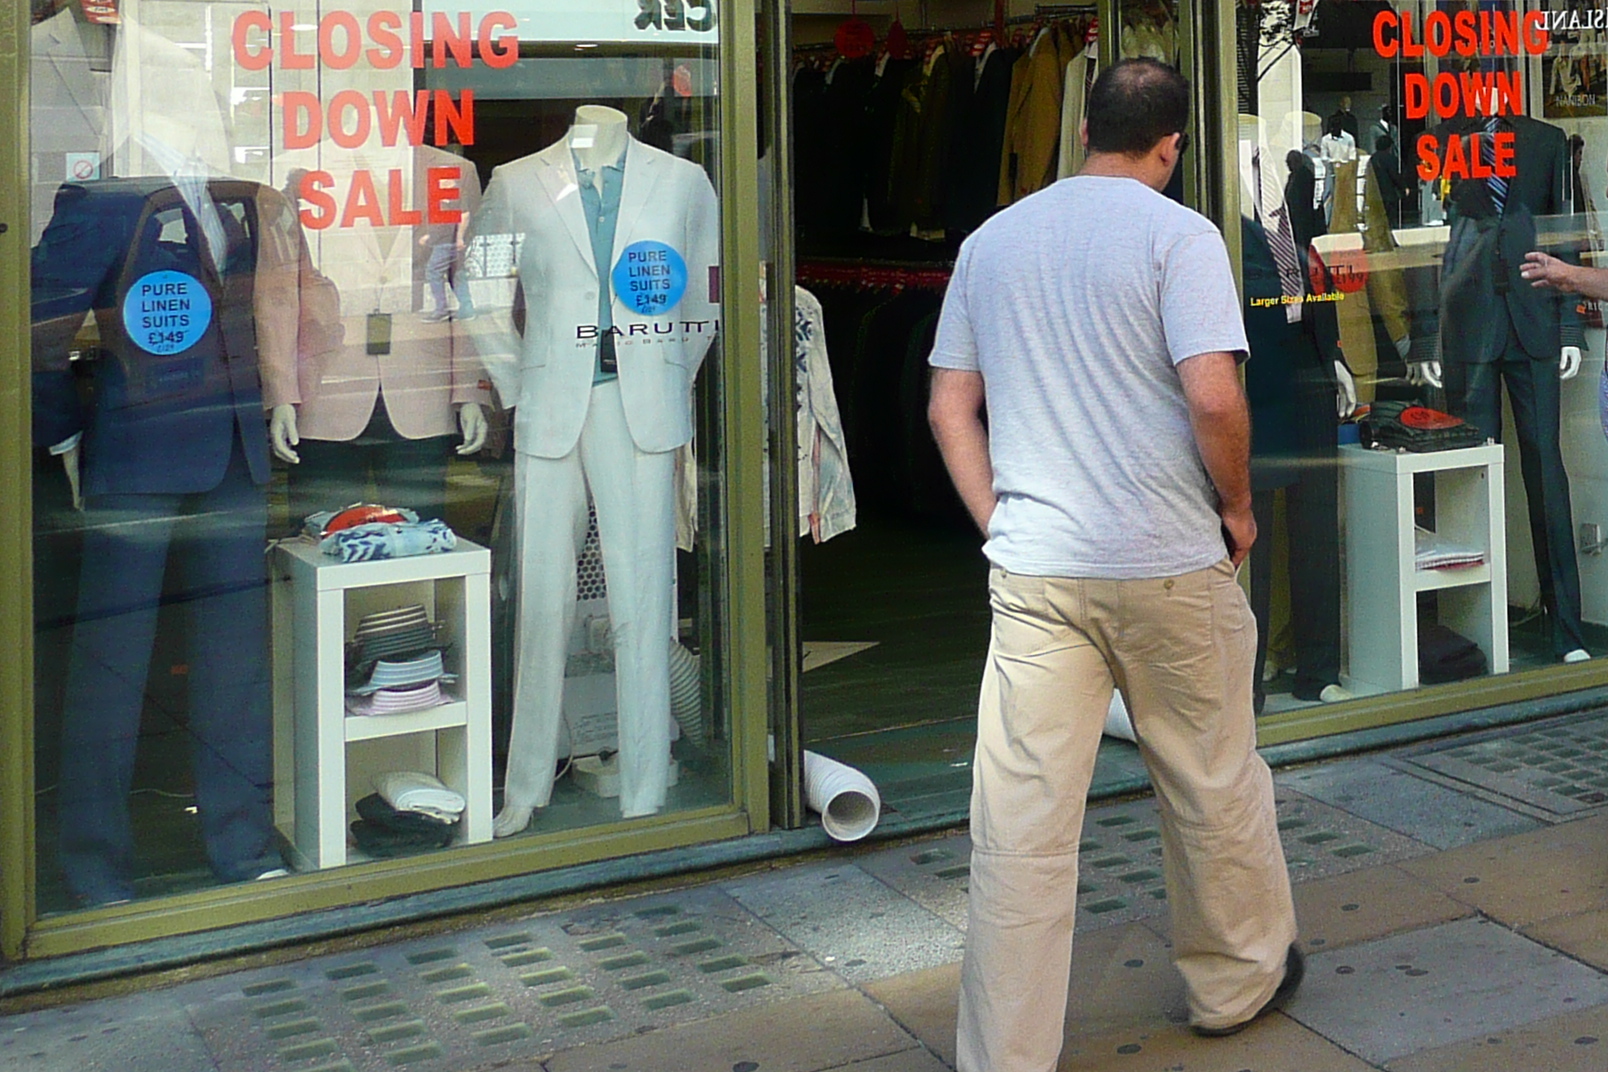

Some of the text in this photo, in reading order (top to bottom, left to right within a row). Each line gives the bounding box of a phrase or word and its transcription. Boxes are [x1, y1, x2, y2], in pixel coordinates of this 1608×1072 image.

[231, 11, 520, 71] CLOSING
[1373, 10, 1549, 58] CLOSING
[1405, 72, 1523, 119] DOWN
[282, 90, 475, 150] DOWN
[1416, 132, 1517, 181] SALE
[300, 167, 463, 230] SALE
[628, 250, 667, 263] PURE
[629, 265, 671, 277] LINEN
[142, 283, 187, 296] PURE
[629, 278, 671, 292] SUITS
[142, 299, 190, 313] LINEN
[1250, 296, 1279, 307] Larger
[1306, 292, 1344, 303] Available
[142, 314, 190, 328] SUITS
[576, 319, 720, 339] BARUTTI
